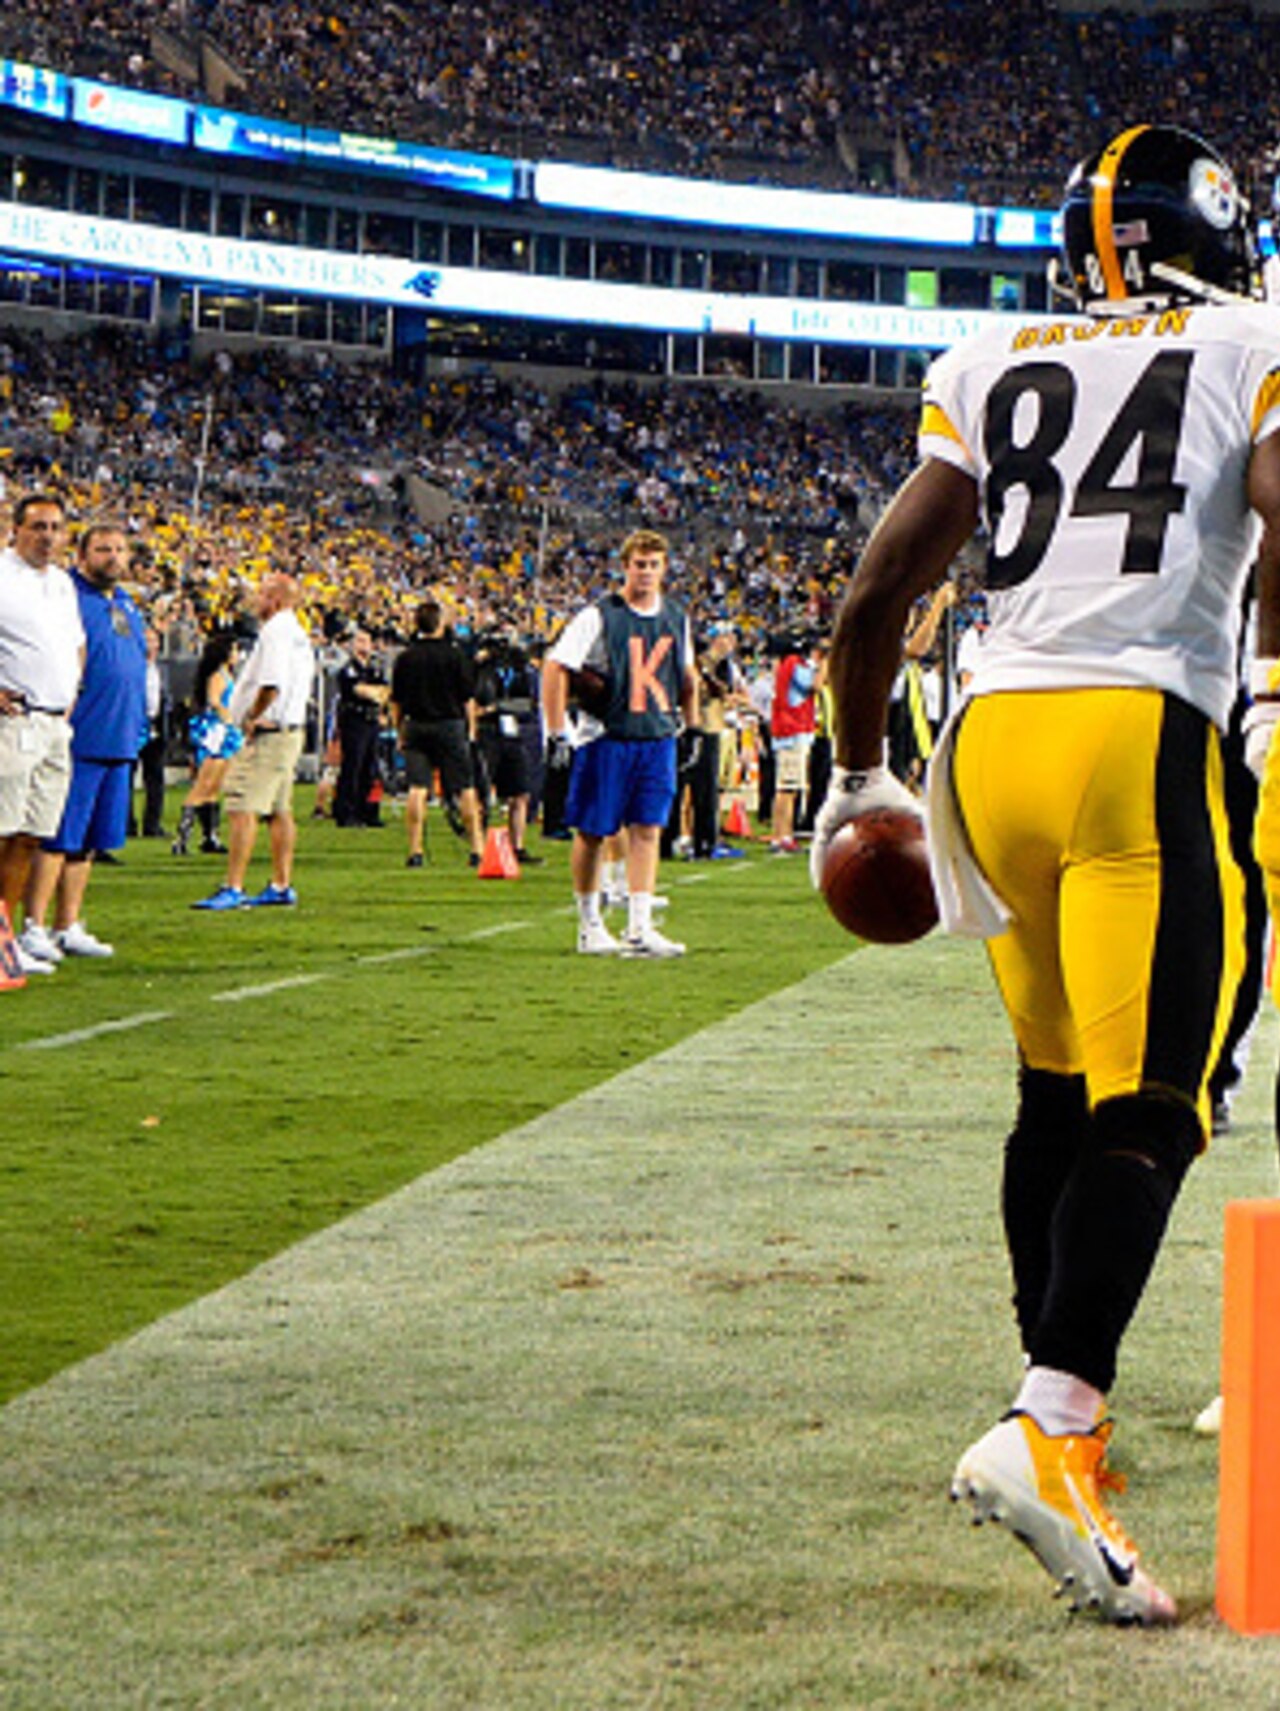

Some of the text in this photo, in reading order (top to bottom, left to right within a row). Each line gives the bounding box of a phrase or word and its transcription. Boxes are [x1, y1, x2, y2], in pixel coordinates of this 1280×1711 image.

[1084, 249, 1145, 294] 84
[1010, 308, 1192, 352] BROWN
[983, 349, 1195, 590] 84
[628, 635, 674, 713] K
